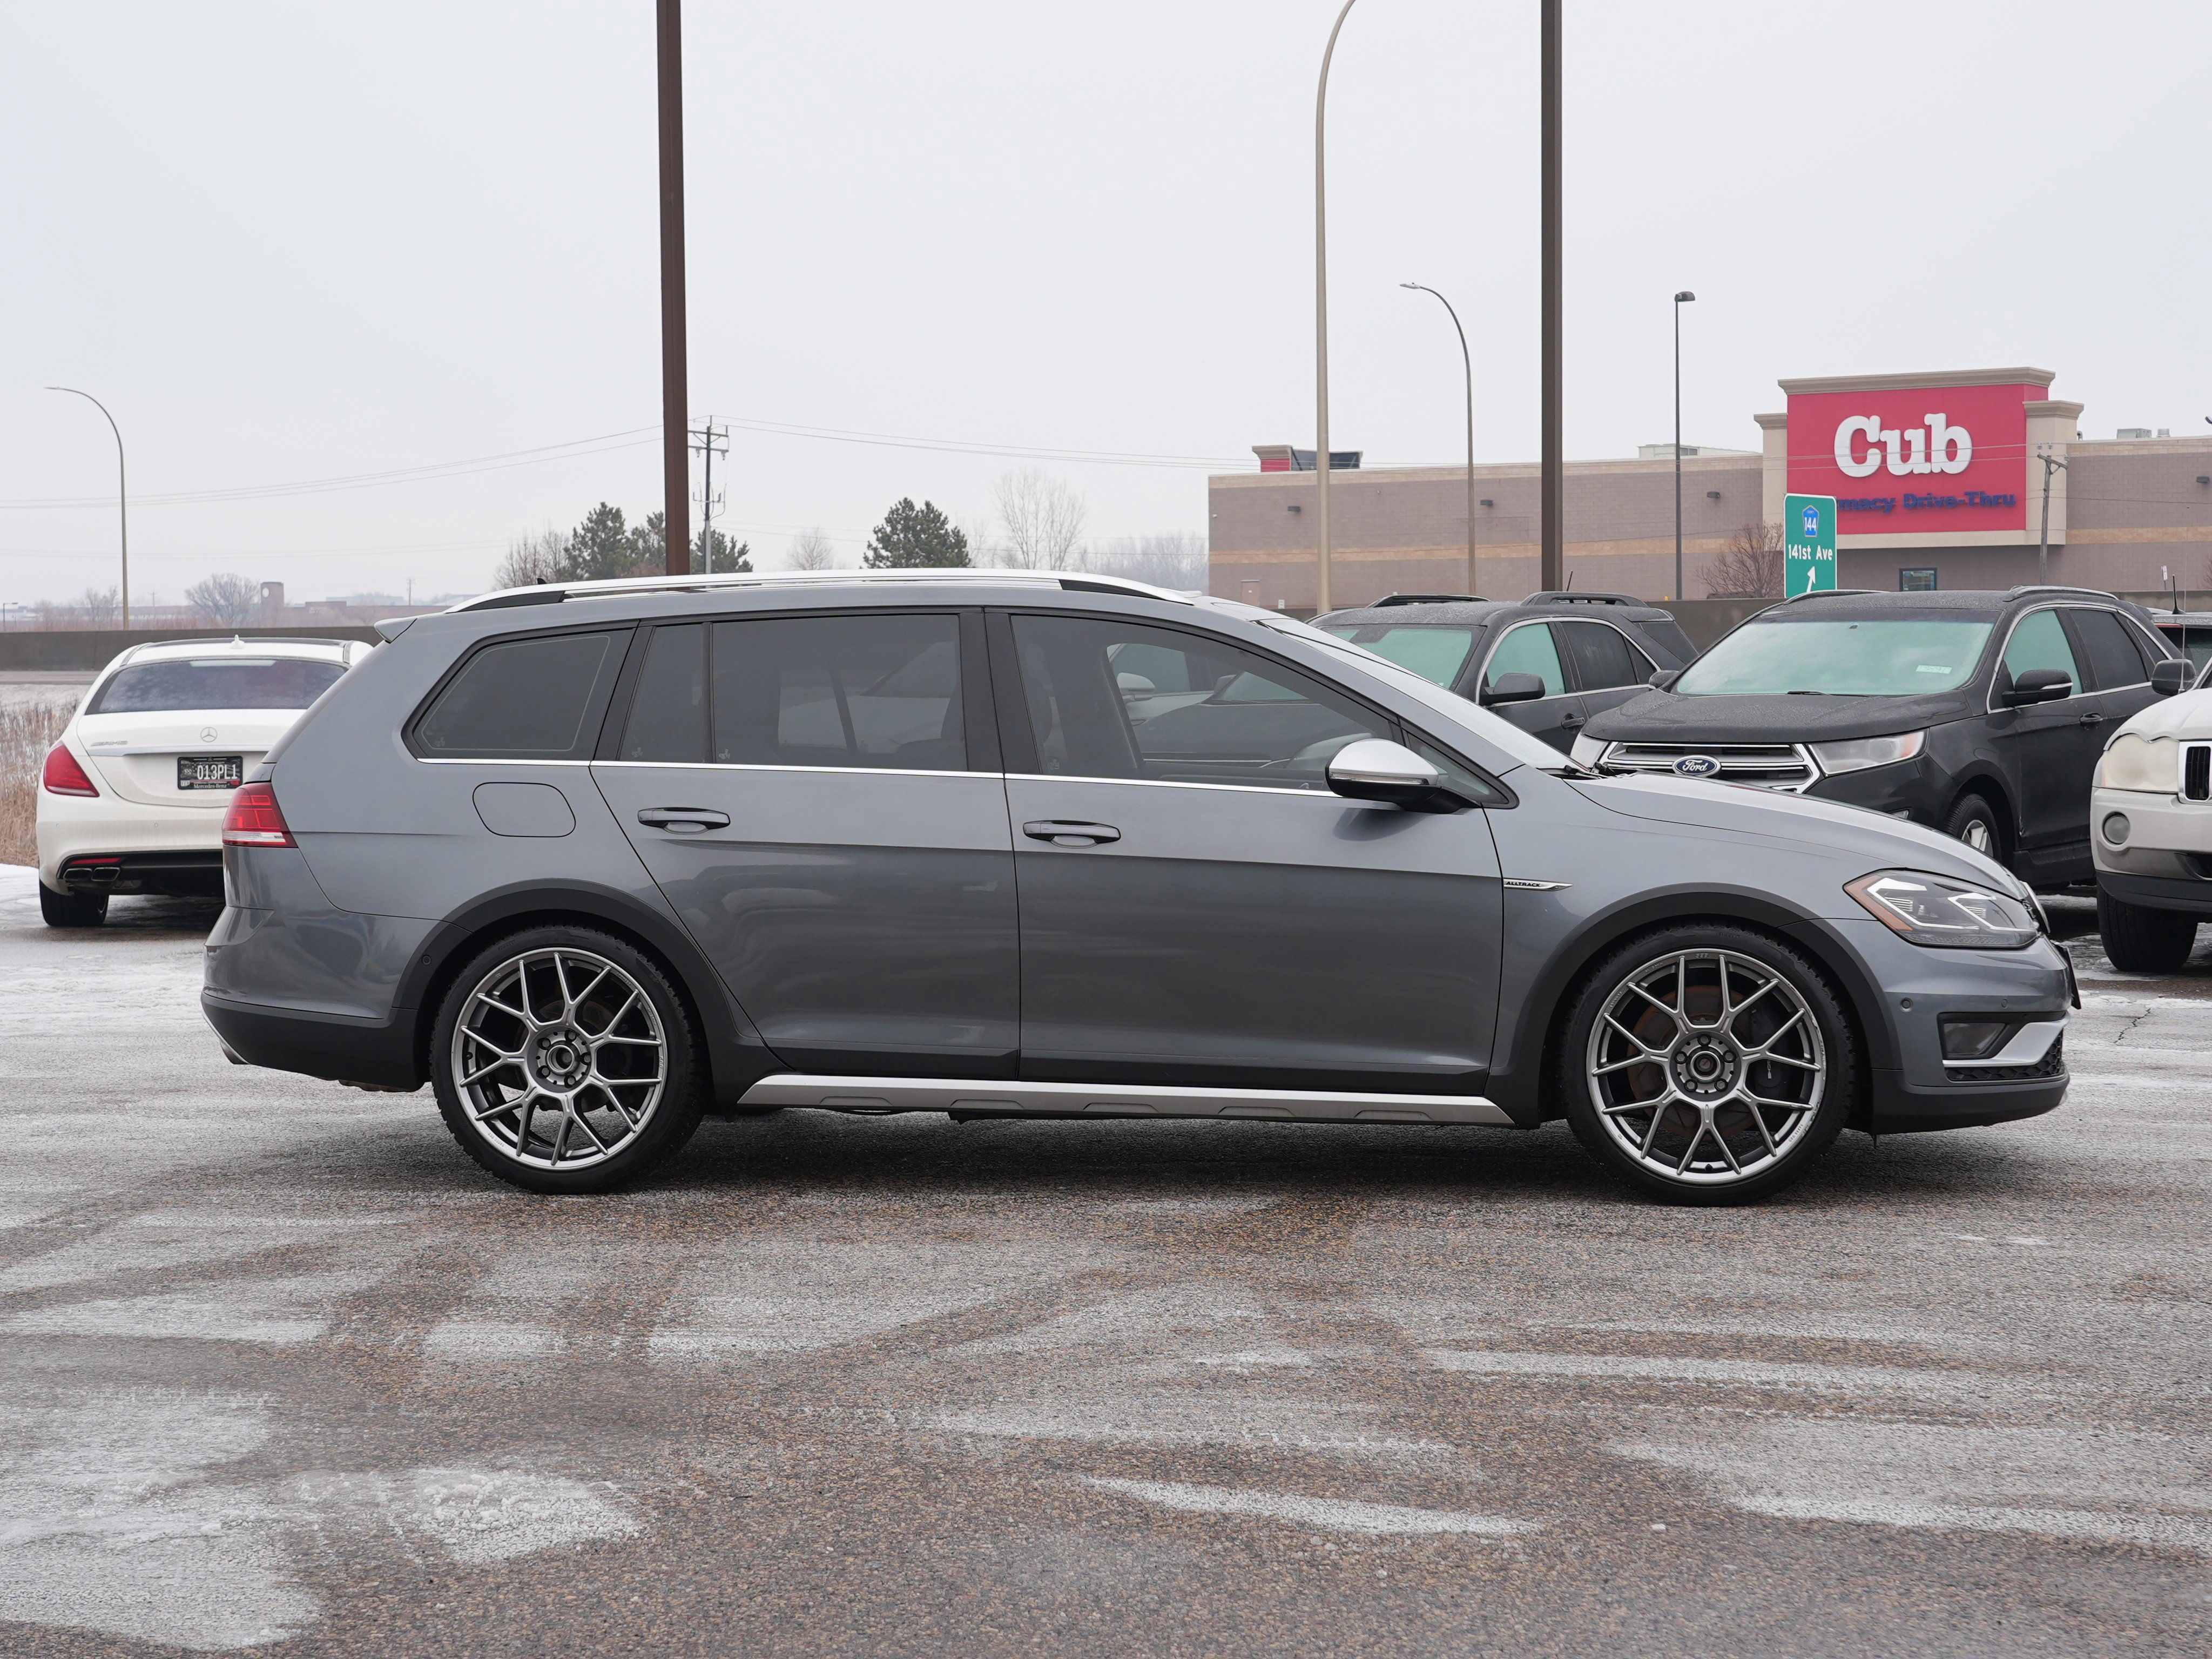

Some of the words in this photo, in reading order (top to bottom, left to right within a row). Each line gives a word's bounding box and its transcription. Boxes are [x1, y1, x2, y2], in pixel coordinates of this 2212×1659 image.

[1834, 413, 1972, 478] Cub
[1837, 497, 1896, 513] macy
[1903, 491, 2015, 509] Drive-Thru
[1804, 517, 1817, 531] 144
[1788, 544, 1811, 560] 141st
[1816, 545, 1833, 561] Ave
[197, 764, 238, 780] 013PL1
[1682, 759, 1709, 772] Ford
